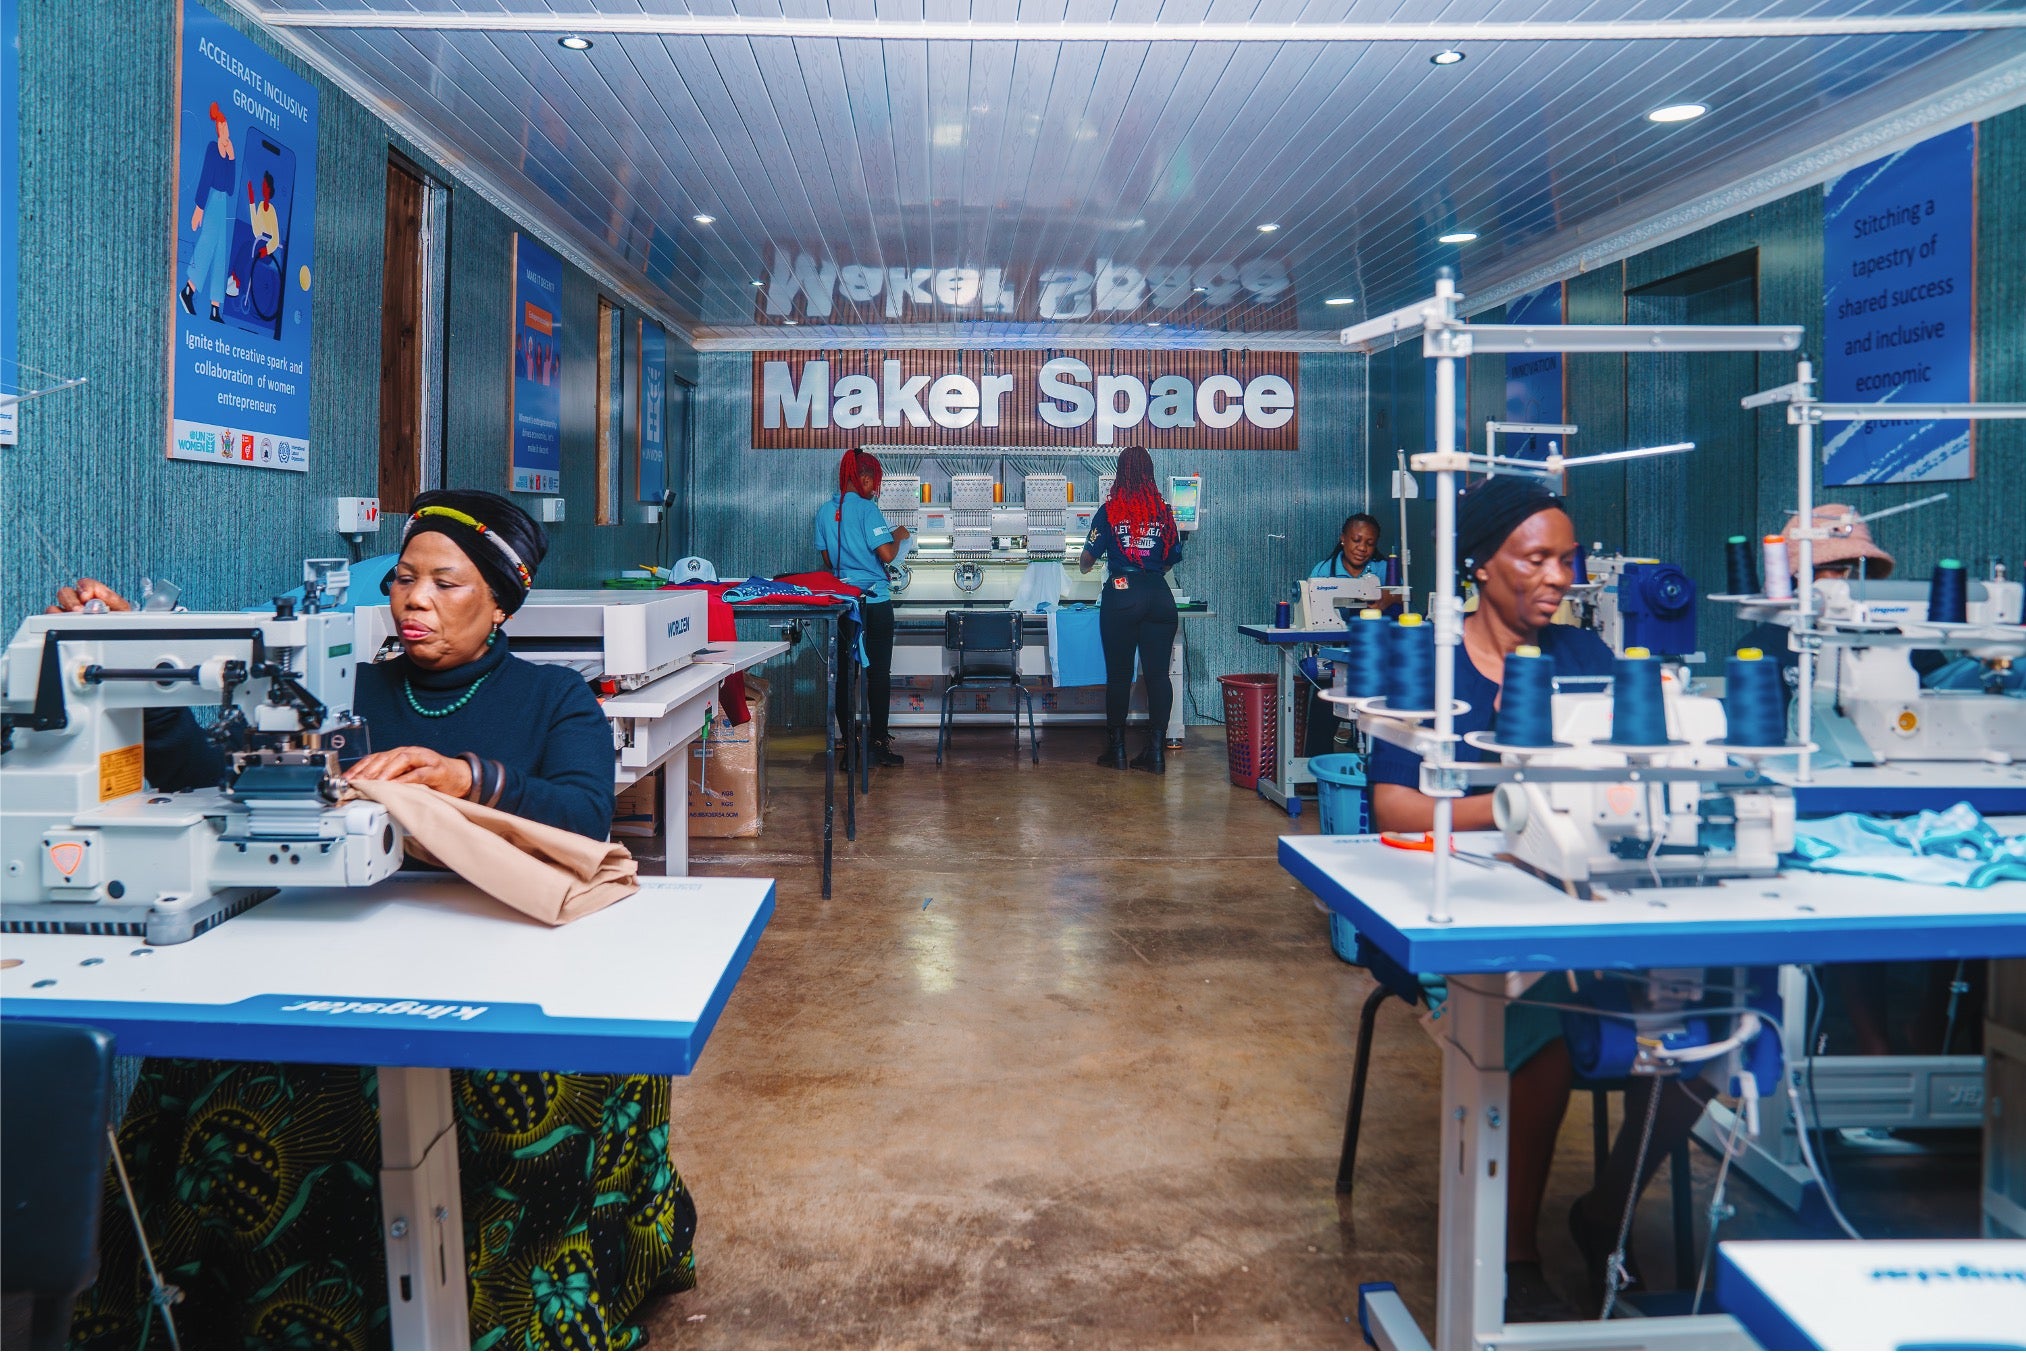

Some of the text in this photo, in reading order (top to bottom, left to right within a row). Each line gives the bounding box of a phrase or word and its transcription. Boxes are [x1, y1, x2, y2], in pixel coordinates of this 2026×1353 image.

[199, 37, 308, 122] ACCELERATE INCLUSIVE
[233, 89, 279, 131] GROWTH!
[1854, 199, 1935, 239] Stitching a
[1852, 233, 1938, 278] tapestry of
[1838, 276, 1954, 320] shared success
[185, 330, 303, 374] Ignite the creative spark and
[1845, 320, 1945, 356] and inclusive
[194, 360, 296, 396] collaboration of women
[1856, 362, 1932, 392] economic
[217, 391, 277, 415] entrepreneurs
[763, 356, 1294, 443] Maker Space
[281, 1000, 488, 1021] kingstar
